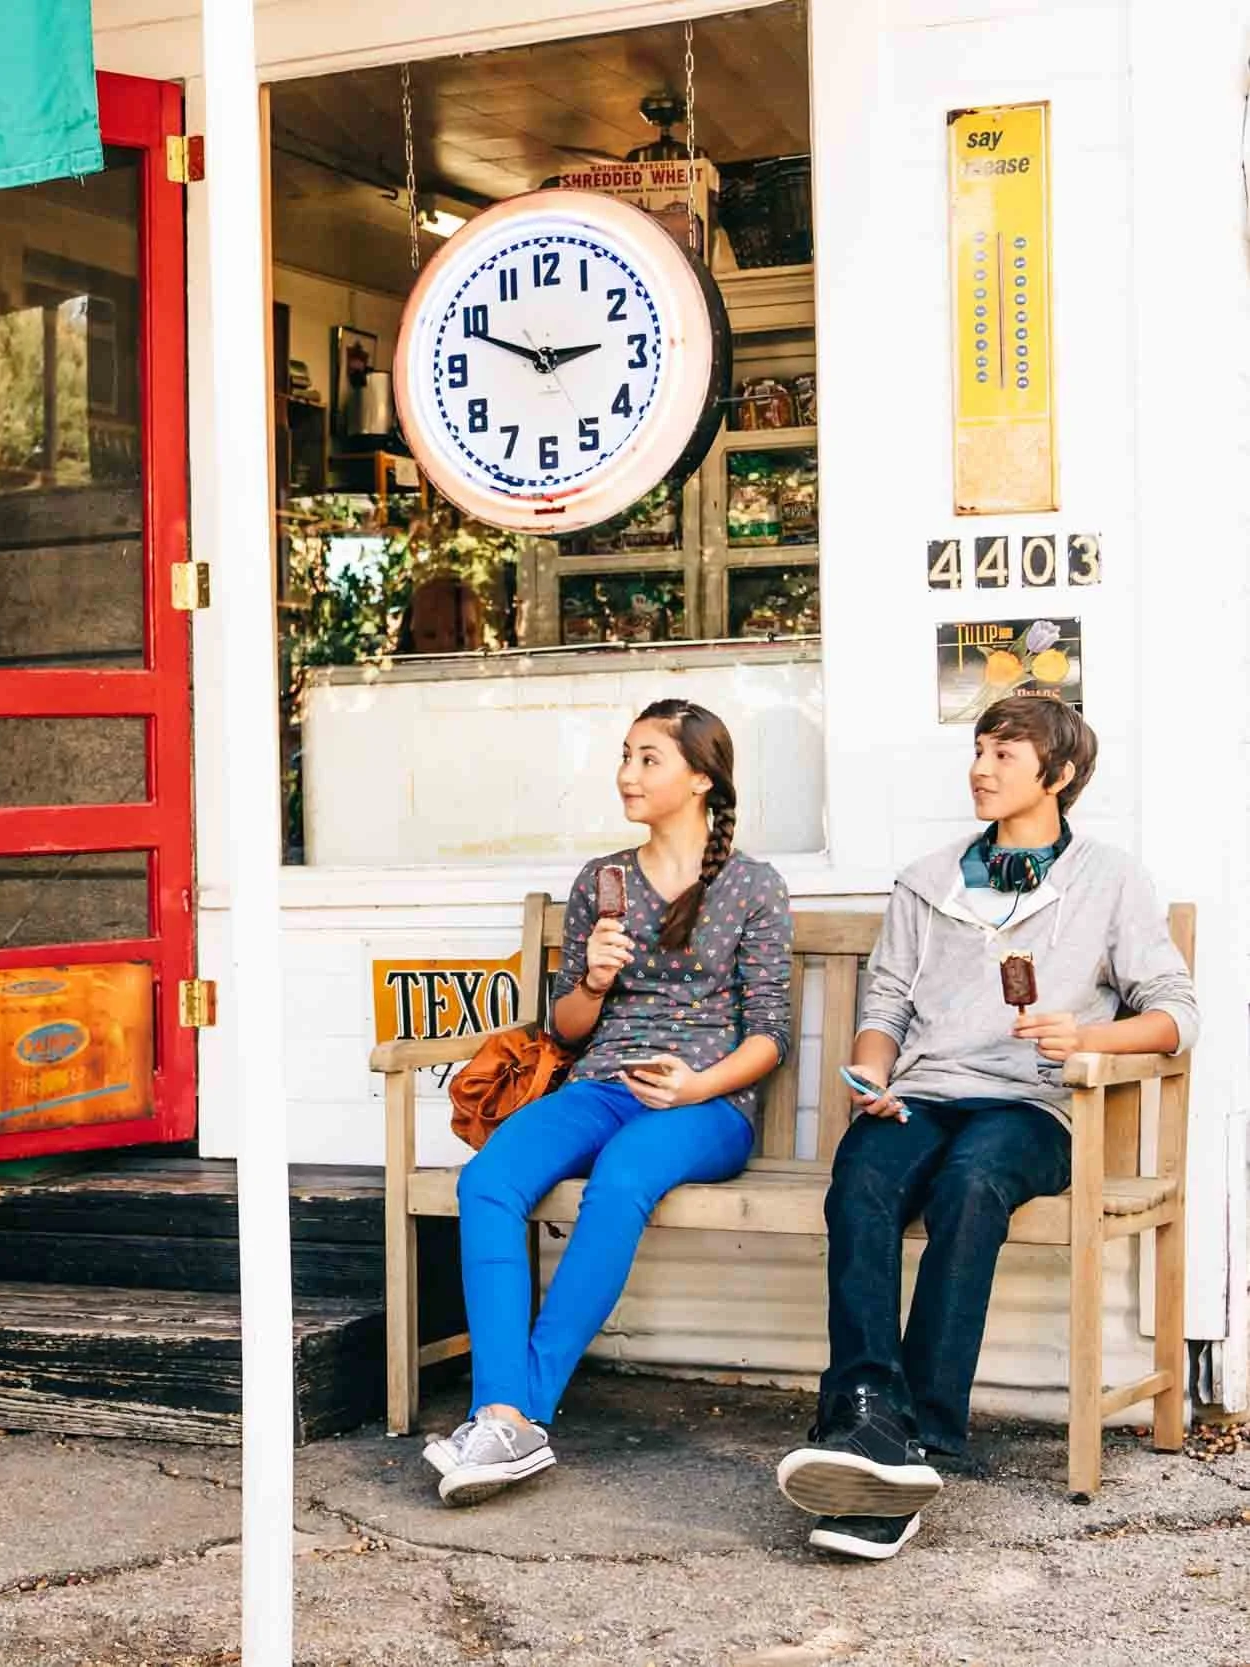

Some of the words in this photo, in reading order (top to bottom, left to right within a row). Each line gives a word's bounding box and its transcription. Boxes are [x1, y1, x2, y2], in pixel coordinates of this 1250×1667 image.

[967, 130, 1003, 151] say
[561, 170, 642, 188] SHREDDED
[500, 268, 518, 302] 11
[533, 252, 561, 288] 12
[579, 258, 588, 292] 1
[463, 304, 489, 338] 10
[606, 288, 627, 322] 2
[627, 333, 648, 369] 3
[447, 353, 468, 389] 9
[467, 398, 488, 433] 8
[610, 383, 633, 418] 4
[500, 425, 520, 460] 7
[578, 416, 600, 452] 5
[538, 435, 559, 470] 6
[928, 536, 1099, 590] 4403
[955, 624, 998, 674] TULIP
